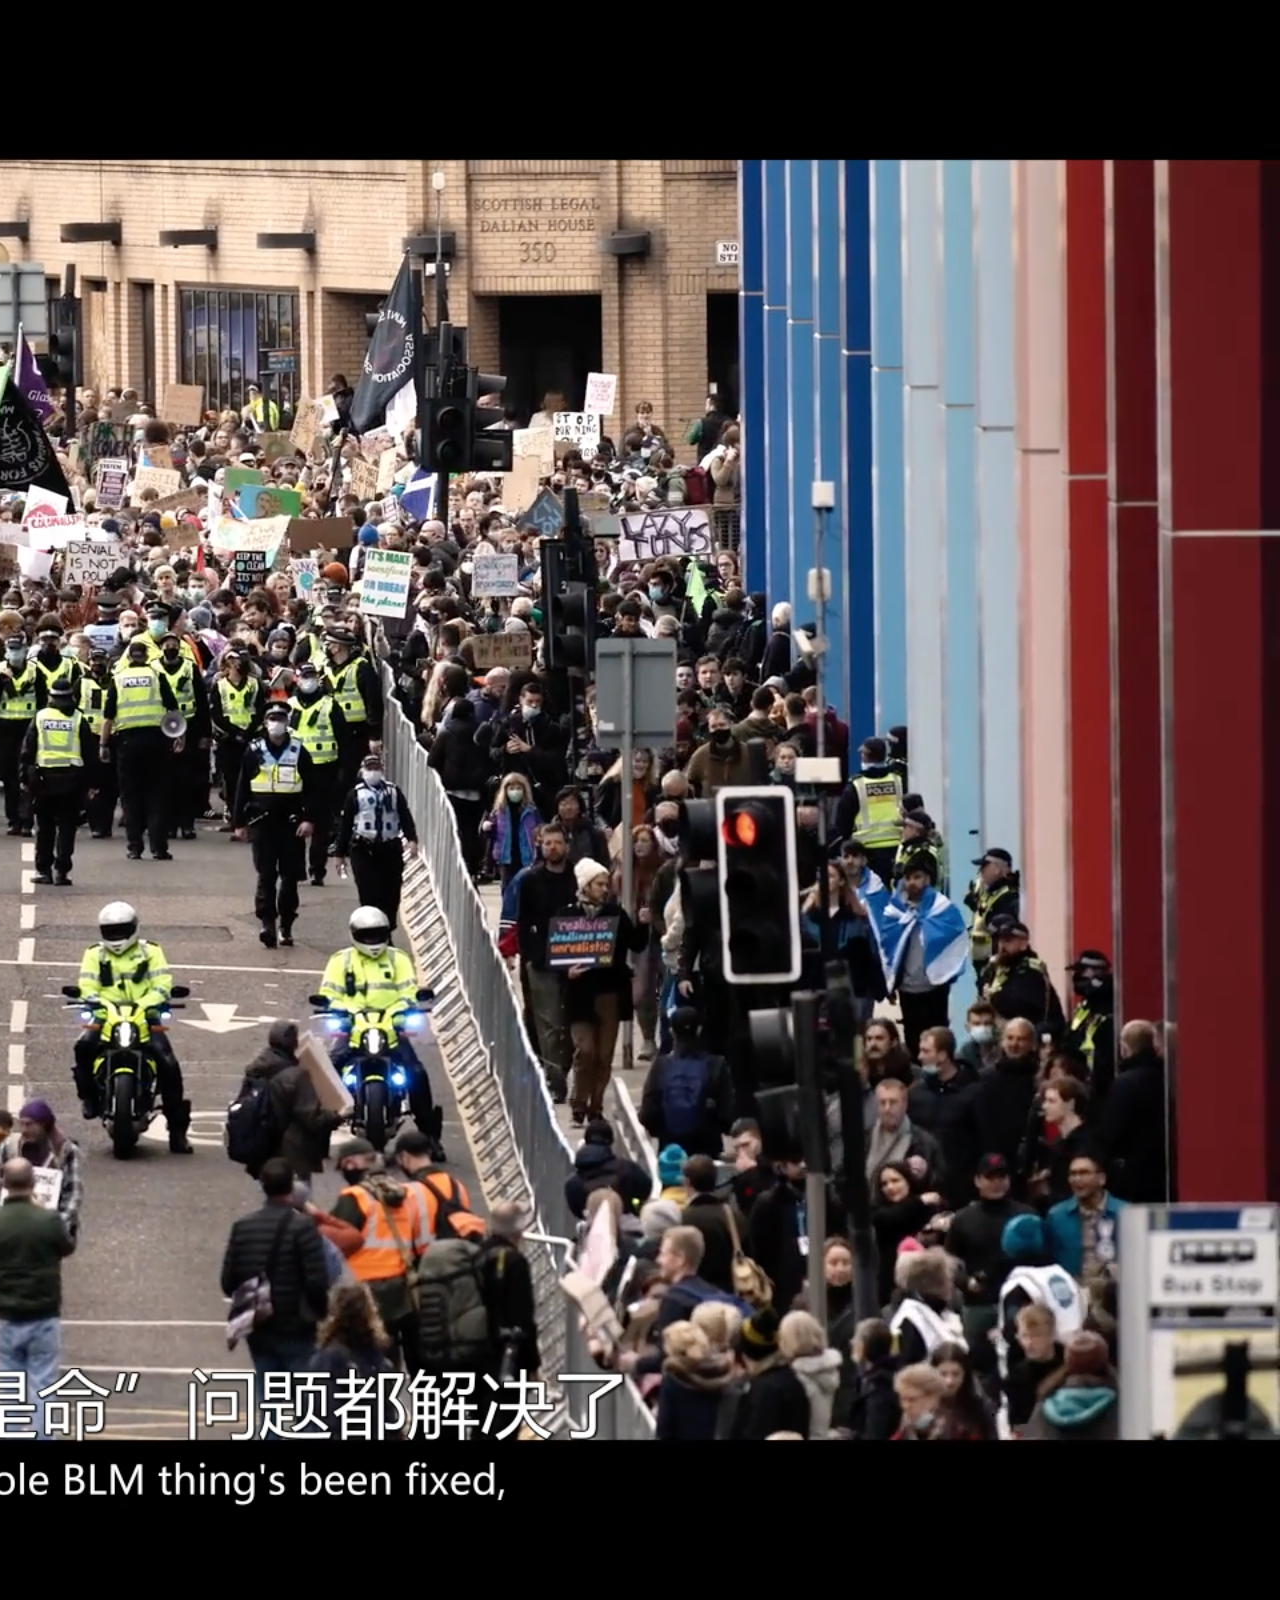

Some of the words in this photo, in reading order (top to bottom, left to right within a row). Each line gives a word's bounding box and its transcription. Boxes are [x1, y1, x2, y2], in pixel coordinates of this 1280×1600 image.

[474, 198, 542, 212] SCOTTISH
[551, 197, 600, 211] LEGAL
[480, 220, 541, 233] DALIAN
[548, 219, 595, 232] HOUSE
[519, 241, 556, 263] 350
[69, 541, 117, 557] DENIAL
[70, 558, 82, 568] IS
[88, 557, 118, 569] NOT
[66, 573, 75, 582] A
[123, 677, 151, 687] POLICE
[43, 720, 73, 731] POLICE
[1162, 1275, 1203, 1294] Bus
[1211, 1275, 1263, 1296] Stop
